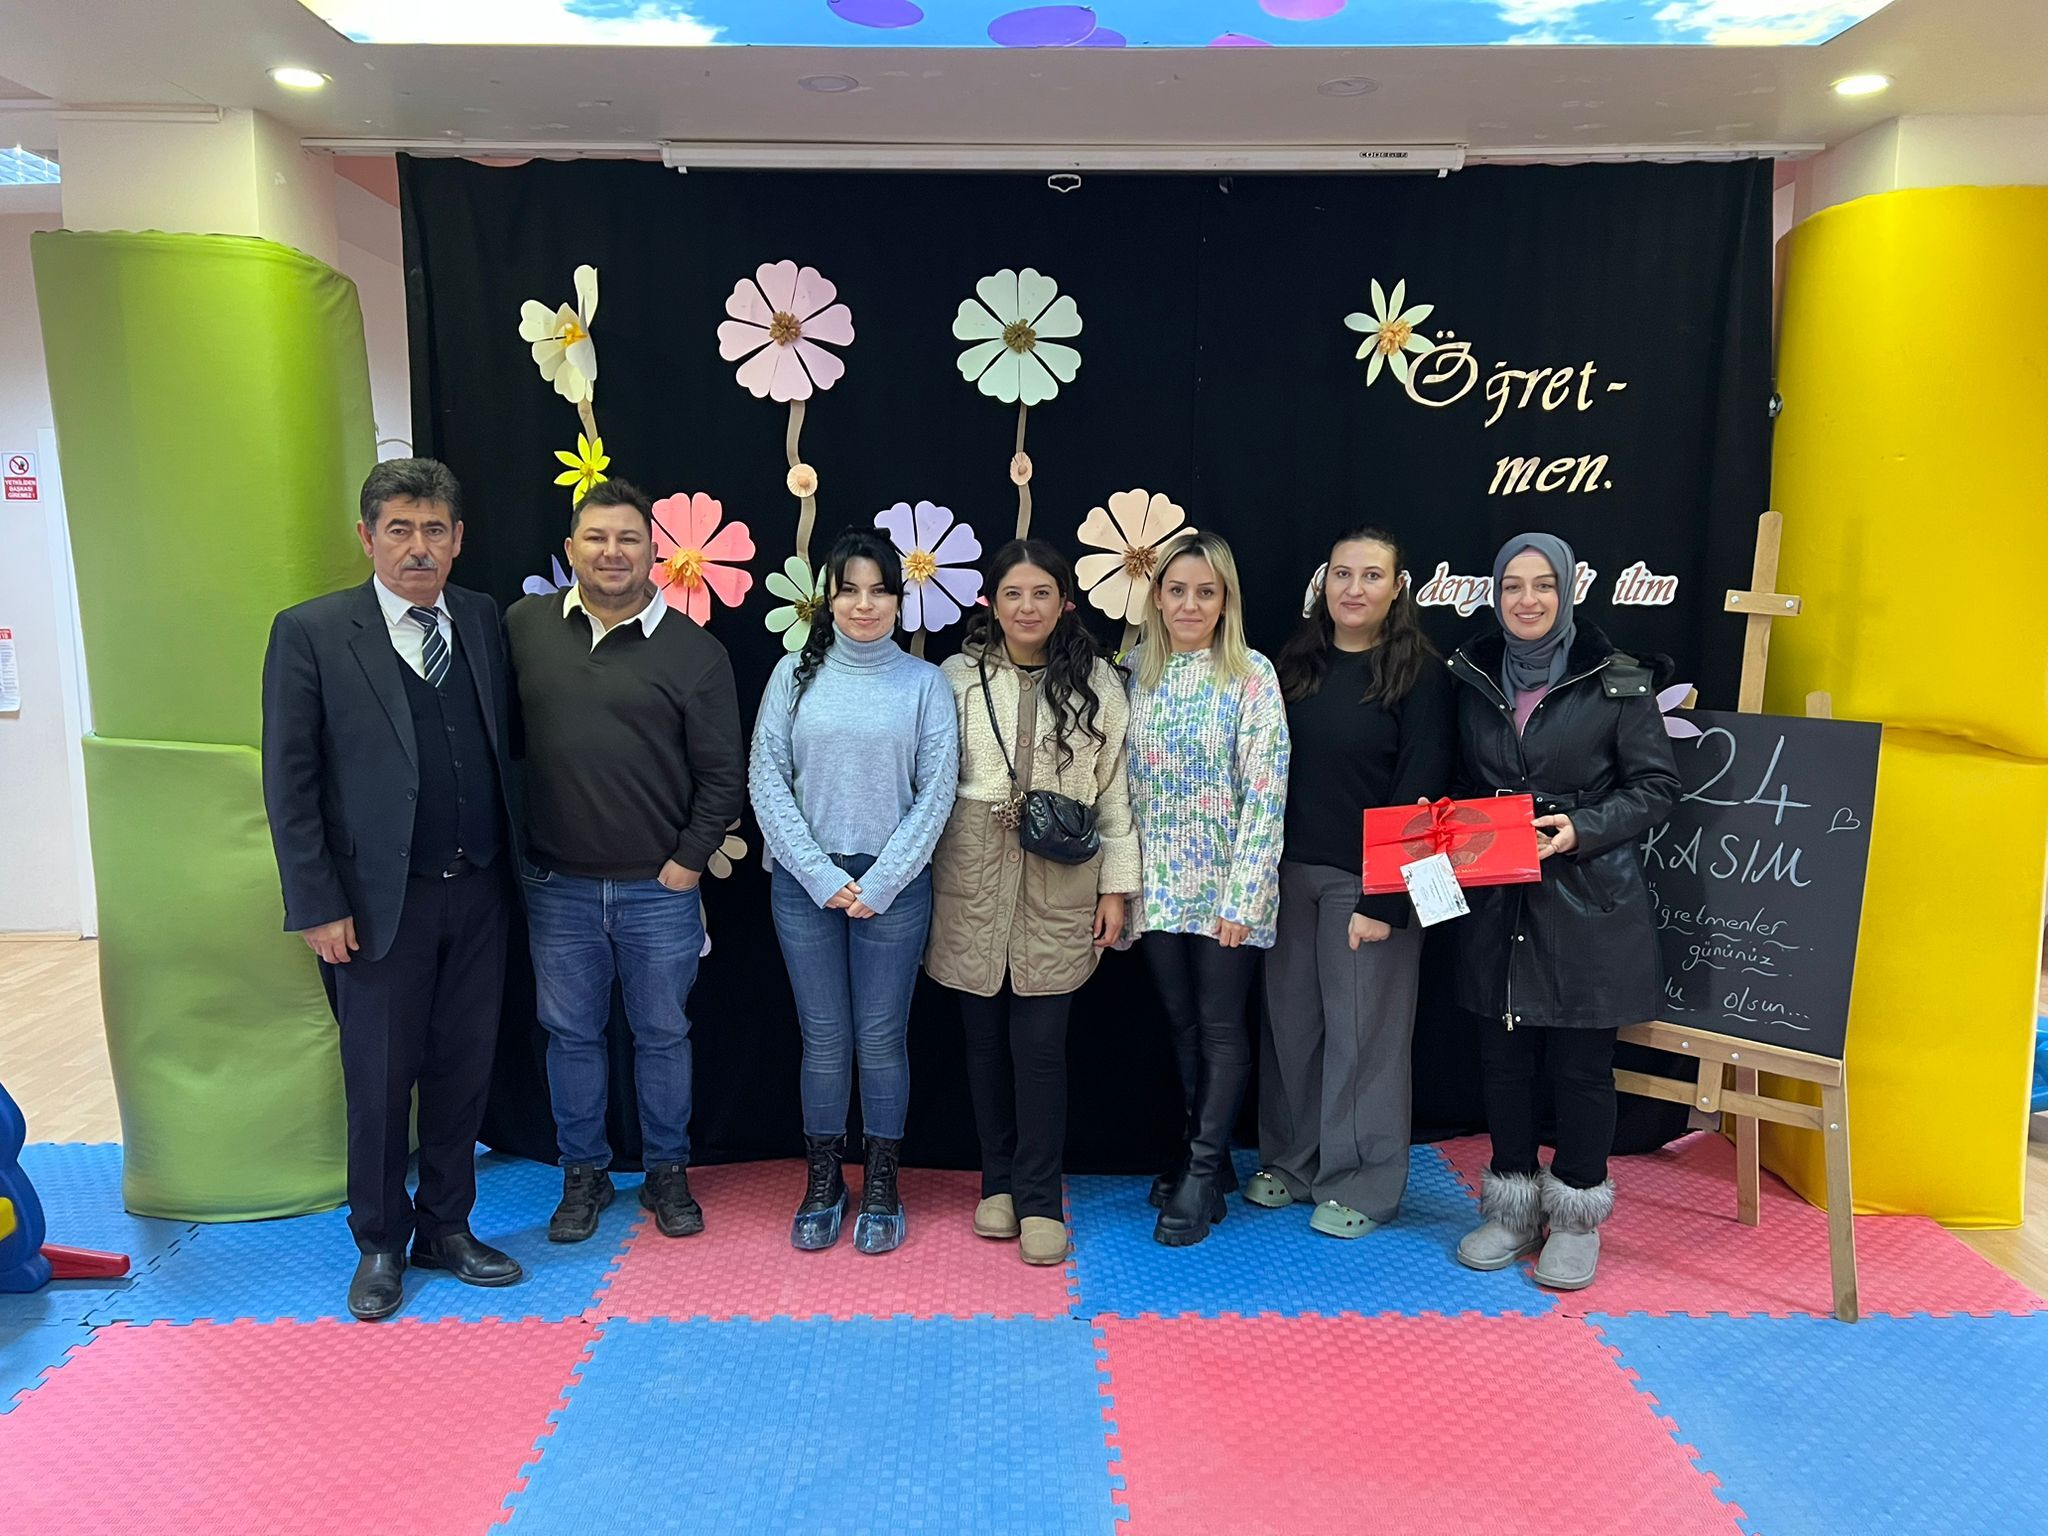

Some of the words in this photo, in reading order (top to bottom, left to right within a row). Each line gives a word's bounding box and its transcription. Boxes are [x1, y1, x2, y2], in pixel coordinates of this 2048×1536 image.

[1488, 454, 1614, 496] men.
[1418, 564, 1494, 615] dery
[1615, 564, 1677, 602] ilim
[1680, 727, 1811, 825] 24
[1640, 822, 1811, 887] KASIM
[1681, 940, 1775, 972] gününüz
